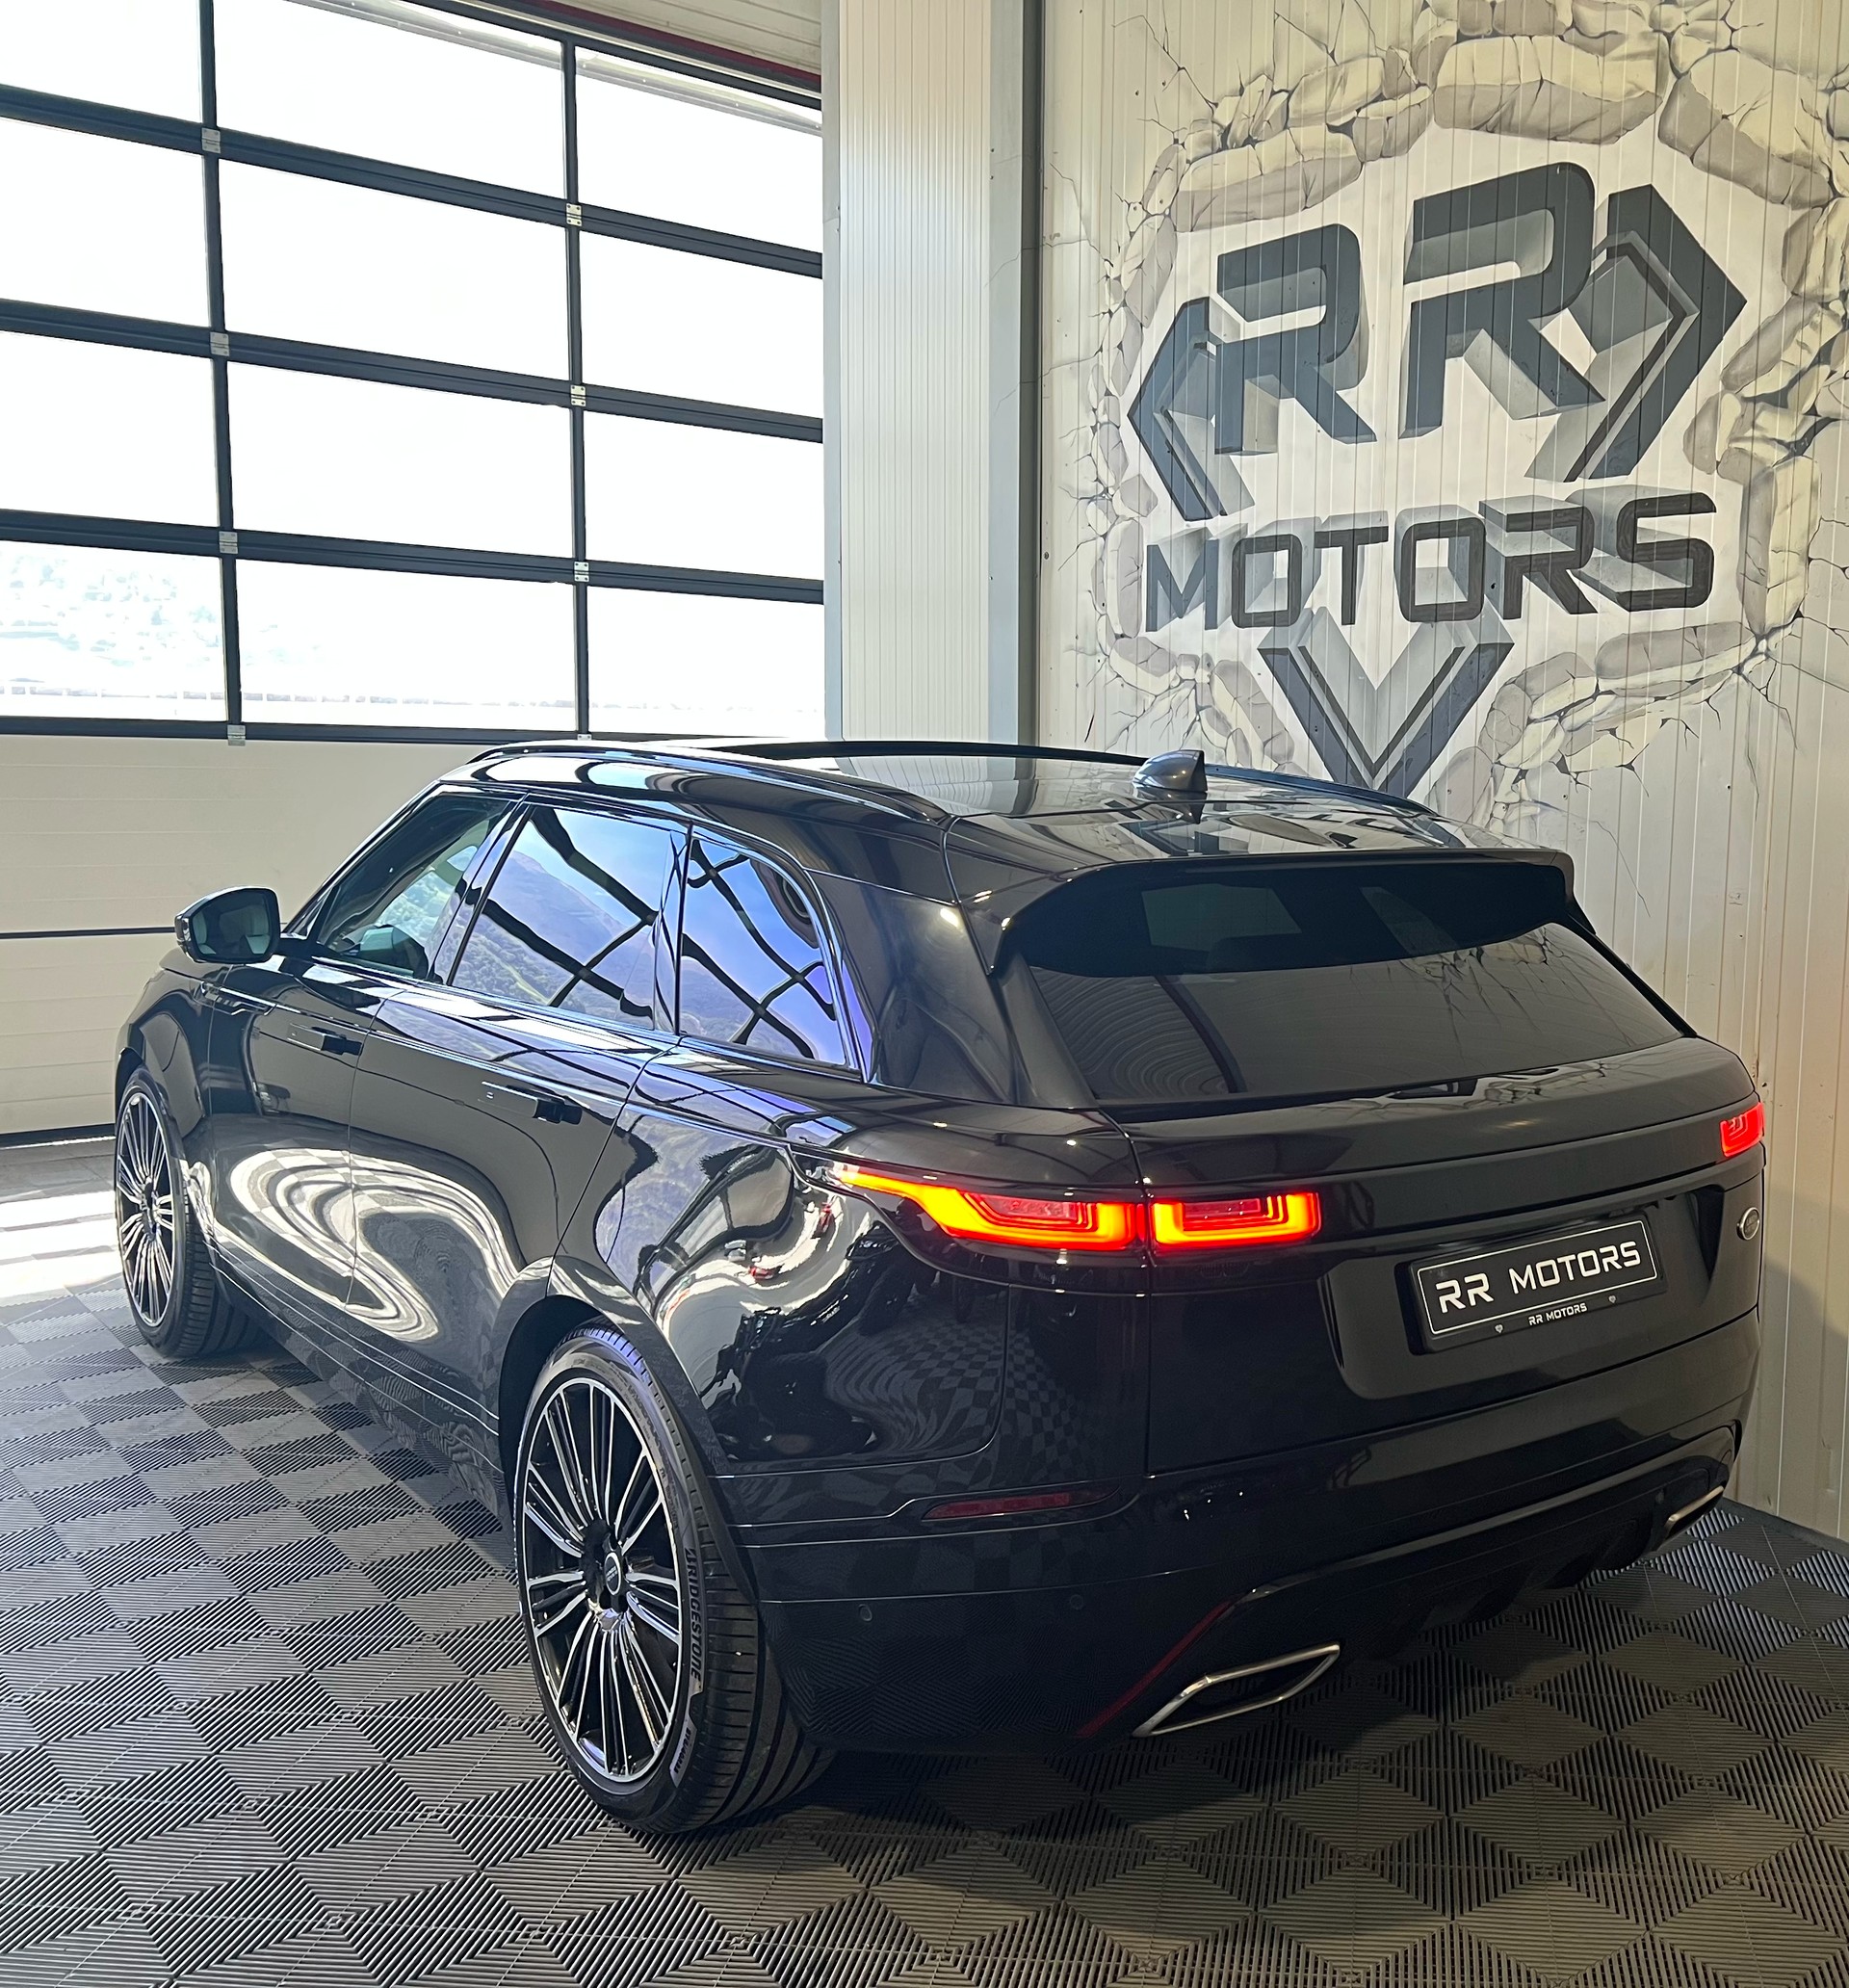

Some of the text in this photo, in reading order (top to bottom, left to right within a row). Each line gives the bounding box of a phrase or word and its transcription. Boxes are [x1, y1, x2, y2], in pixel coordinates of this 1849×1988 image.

[1214, 162, 1605, 455] RR
[1146, 488, 1717, 633] MOTORS
[1435, 1241, 1641, 1314] RR MOTORS
[1528, 1302, 1588, 1326] RR MOTORS
[684, 1547, 702, 1682] BRIDGESTONE
